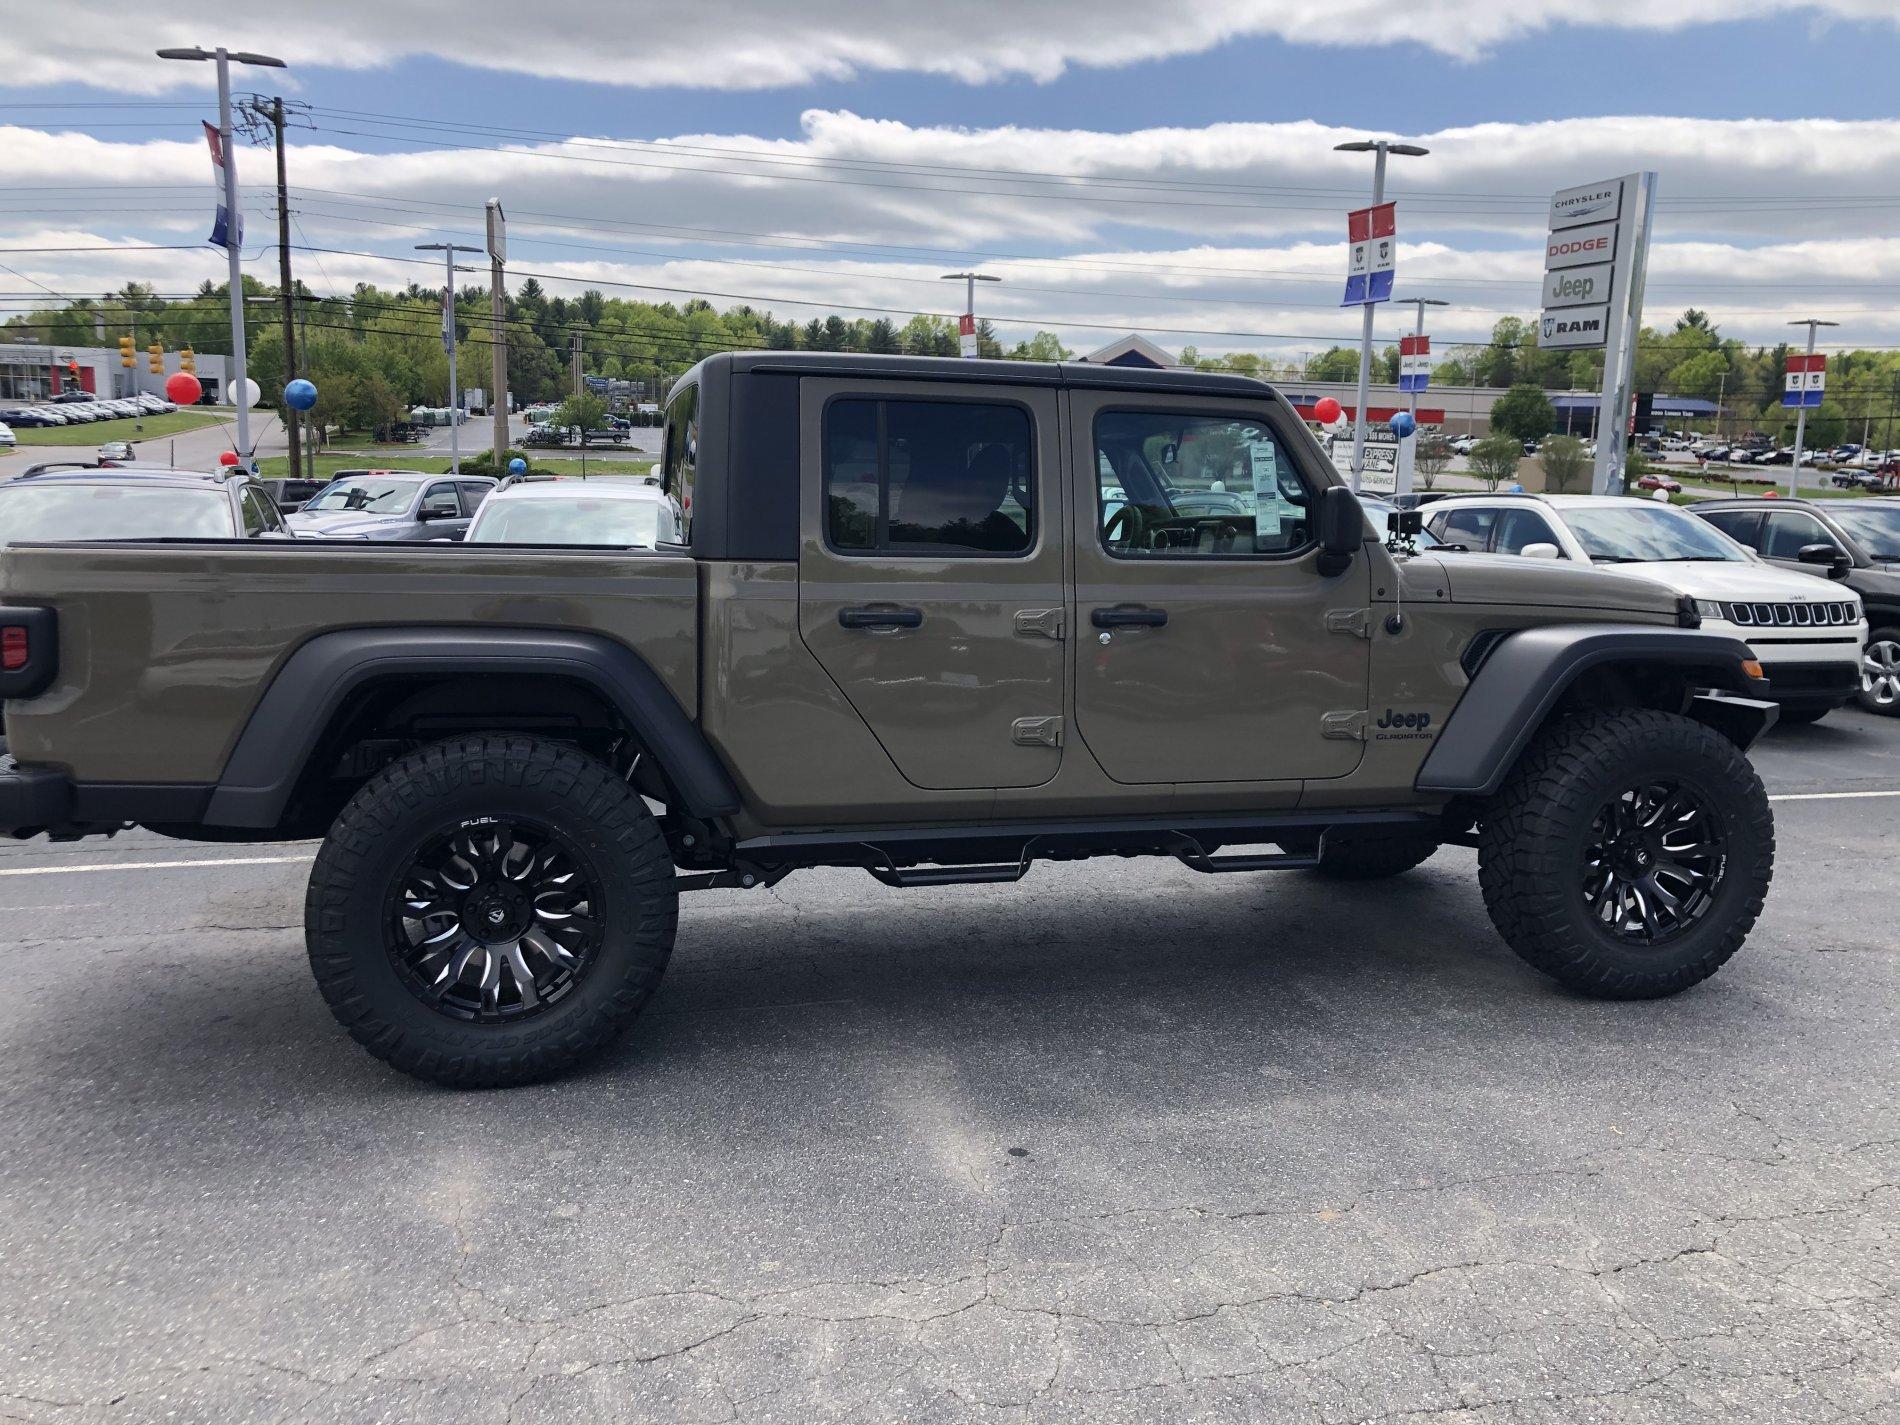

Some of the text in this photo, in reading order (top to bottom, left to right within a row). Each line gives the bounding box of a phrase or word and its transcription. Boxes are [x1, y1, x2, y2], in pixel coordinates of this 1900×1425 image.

[1555, 191, 1612, 208] CHRYSLER
[1549, 237, 1608, 257] DODGE
[1553, 275, 1594, 299] Jeep
[1556, 319, 1600, 333] RAM
[1365, 449, 1395, 460] EXPRESS
[1377, 708, 1431, 731] Jeep
[460, 817, 499, 828] FUEL
[1717, 854, 1727, 882] FUEL
